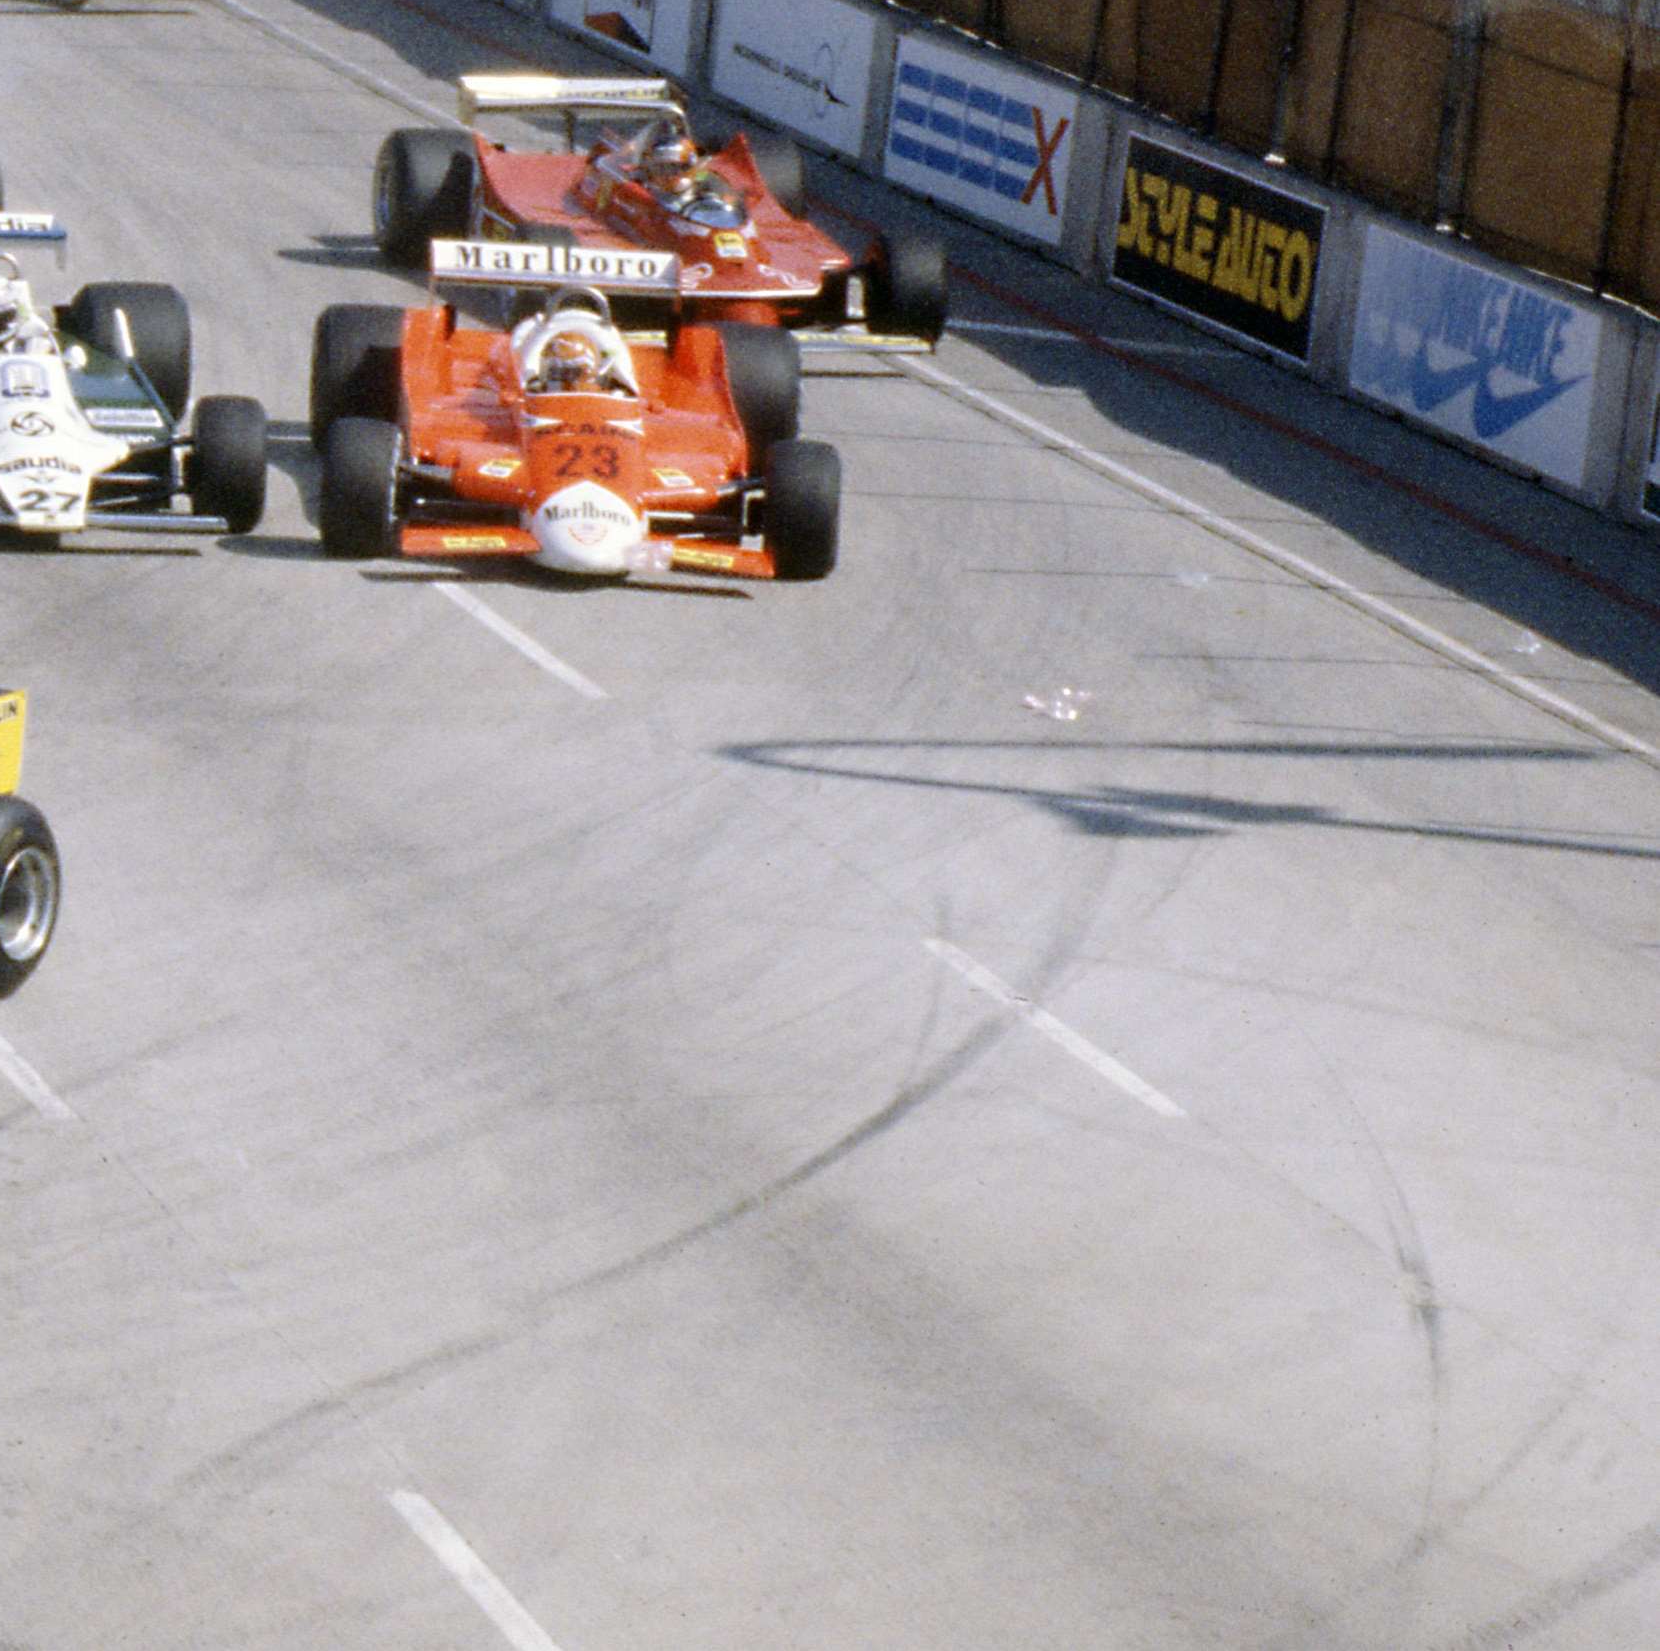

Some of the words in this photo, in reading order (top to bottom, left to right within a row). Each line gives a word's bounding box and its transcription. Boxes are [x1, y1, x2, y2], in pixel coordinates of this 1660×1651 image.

[455, 244, 659, 278] Marlboro
[553, 445, 620, 480] 23
[19, 489, 82, 513] 27
[541, 499, 632, 526] Marlboro
